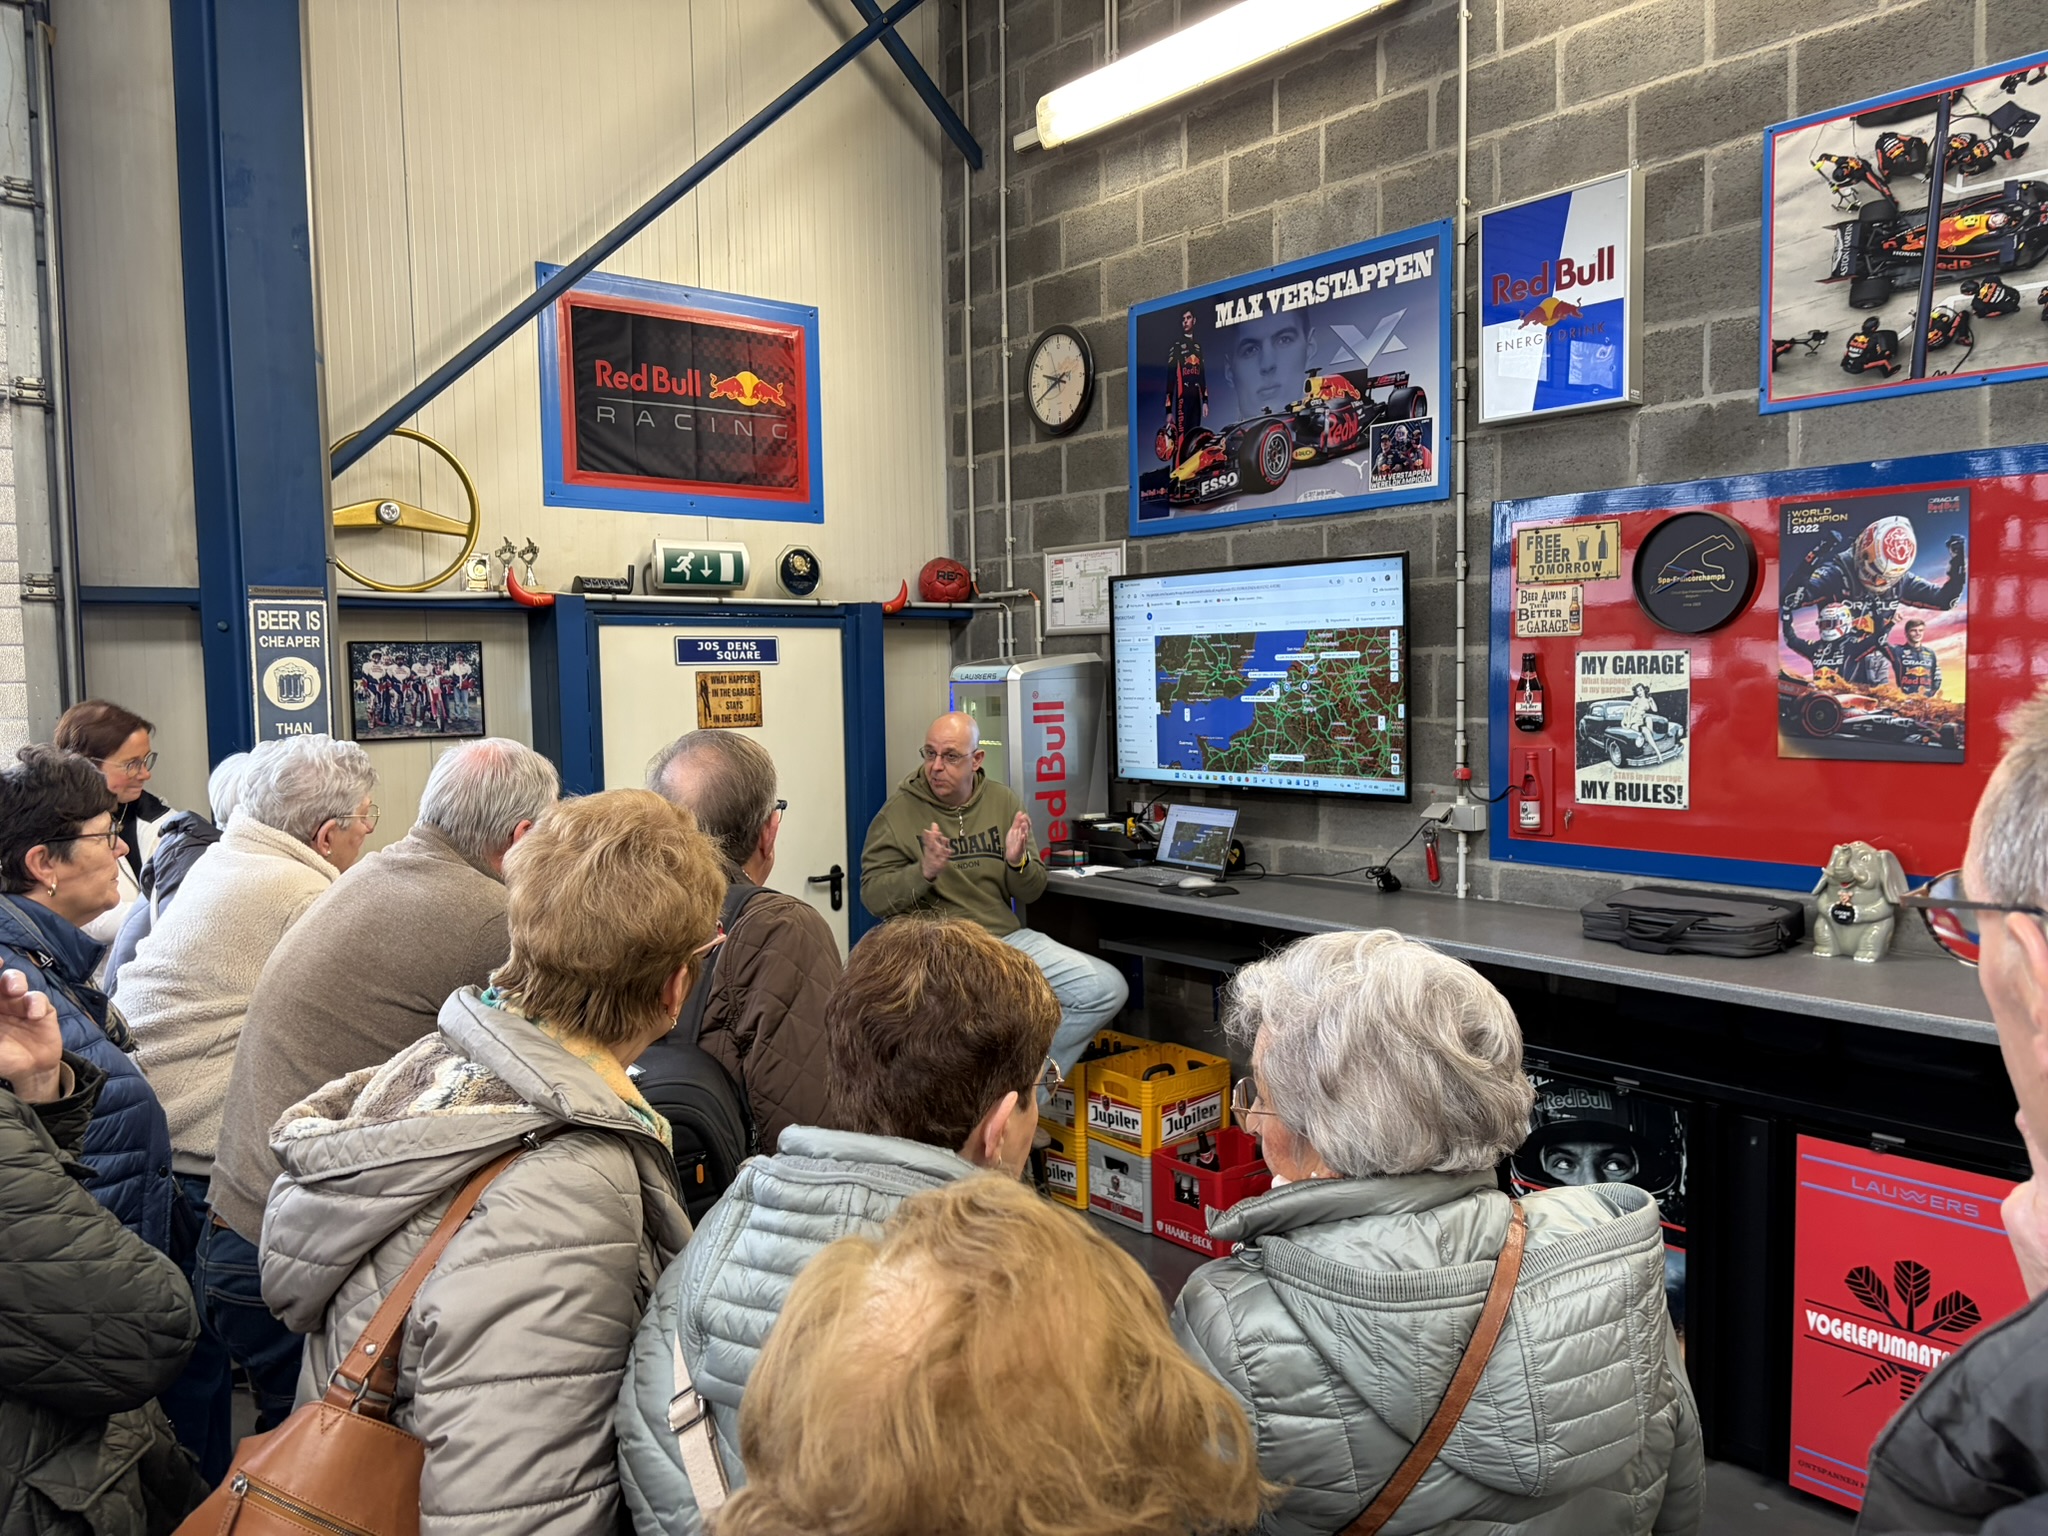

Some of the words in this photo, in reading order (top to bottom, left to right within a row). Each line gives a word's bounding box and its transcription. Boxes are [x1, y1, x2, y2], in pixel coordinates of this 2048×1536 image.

[1492, 261, 1548, 306] Red
[1555, 245, 1614, 291] Bull
[1215, 293, 1263, 328] MAX
[1266, 248, 1434, 316] VERSTAPPEN
[1496, 333, 1552, 353] ENERGY
[1558, 322, 1606, 341] DRINK
[595, 360, 648, 391] Red
[652, 365, 701, 397] Bull
[597, 406, 788, 440] RACING
[1372, 474, 1387, 482] MAX
[1387, 469, 1431, 480] VERSTAPPEN
[1201, 472, 1238, 495] ESSO
[1792, 507, 1832, 518] WORLD
[1928, 503, 1943, 511] Red
[1943, 501, 1960, 510] Bull
[1792, 513, 1848, 526] CHAMPION
[1792, 524, 1819, 534] 2022
[1527, 533, 1561, 550] FREE
[1535, 548, 1570, 564] BEER
[1529, 561, 1602, 576] TOMORROW
[583, 578, 627, 590] SMOKER
[257, 610, 301, 630] BEER
[305, 611, 321, 630] IS
[1527, 619, 1568, 633] GARAGE
[259, 635, 320, 648] CHEAPER
[697, 642, 719, 651] JOS
[727, 642, 756, 651] DENS
[717, 651, 761, 660] SQUARE
[1581, 656, 1608, 675] MY
[1612, 654, 1685, 675] GARAGE
[428, 678, 438, 687] 20
[711, 675, 727, 684] WHAT
[728, 675, 755, 684] HAPPENS
[1582, 677, 1599, 685] What
[712, 689, 719, 697] IN
[720, 688, 731, 697] THE
[732, 687, 755, 697] GARAGE
[726, 701, 743, 710] STAYS
[713, 714, 720, 723] IN
[721, 714, 733, 722] THE
[733, 713, 757, 722] GARAGE
[275, 722, 313, 735] THAN
[1033, 701, 1066, 783] Bull
[1613, 771, 1634, 780] STAYS
[1581, 780, 1610, 800] MY
[1614, 782, 1683, 805] RULES!
[1543, 1088, 1577, 1110] Red
[1576, 1089, 1612, 1110] Bull
[1091, 1105, 1139, 1131] Jupiler
[1165, 1104, 1217, 1136] Jupiler
[1047, 1163, 1074, 1183] piler
[1107, 1187, 1127, 1200] Jupiler
[1164, 1223, 1213, 1251] HAAKE-BECK
[1798, 1459, 1858, 1487] ONTSPANNEN
